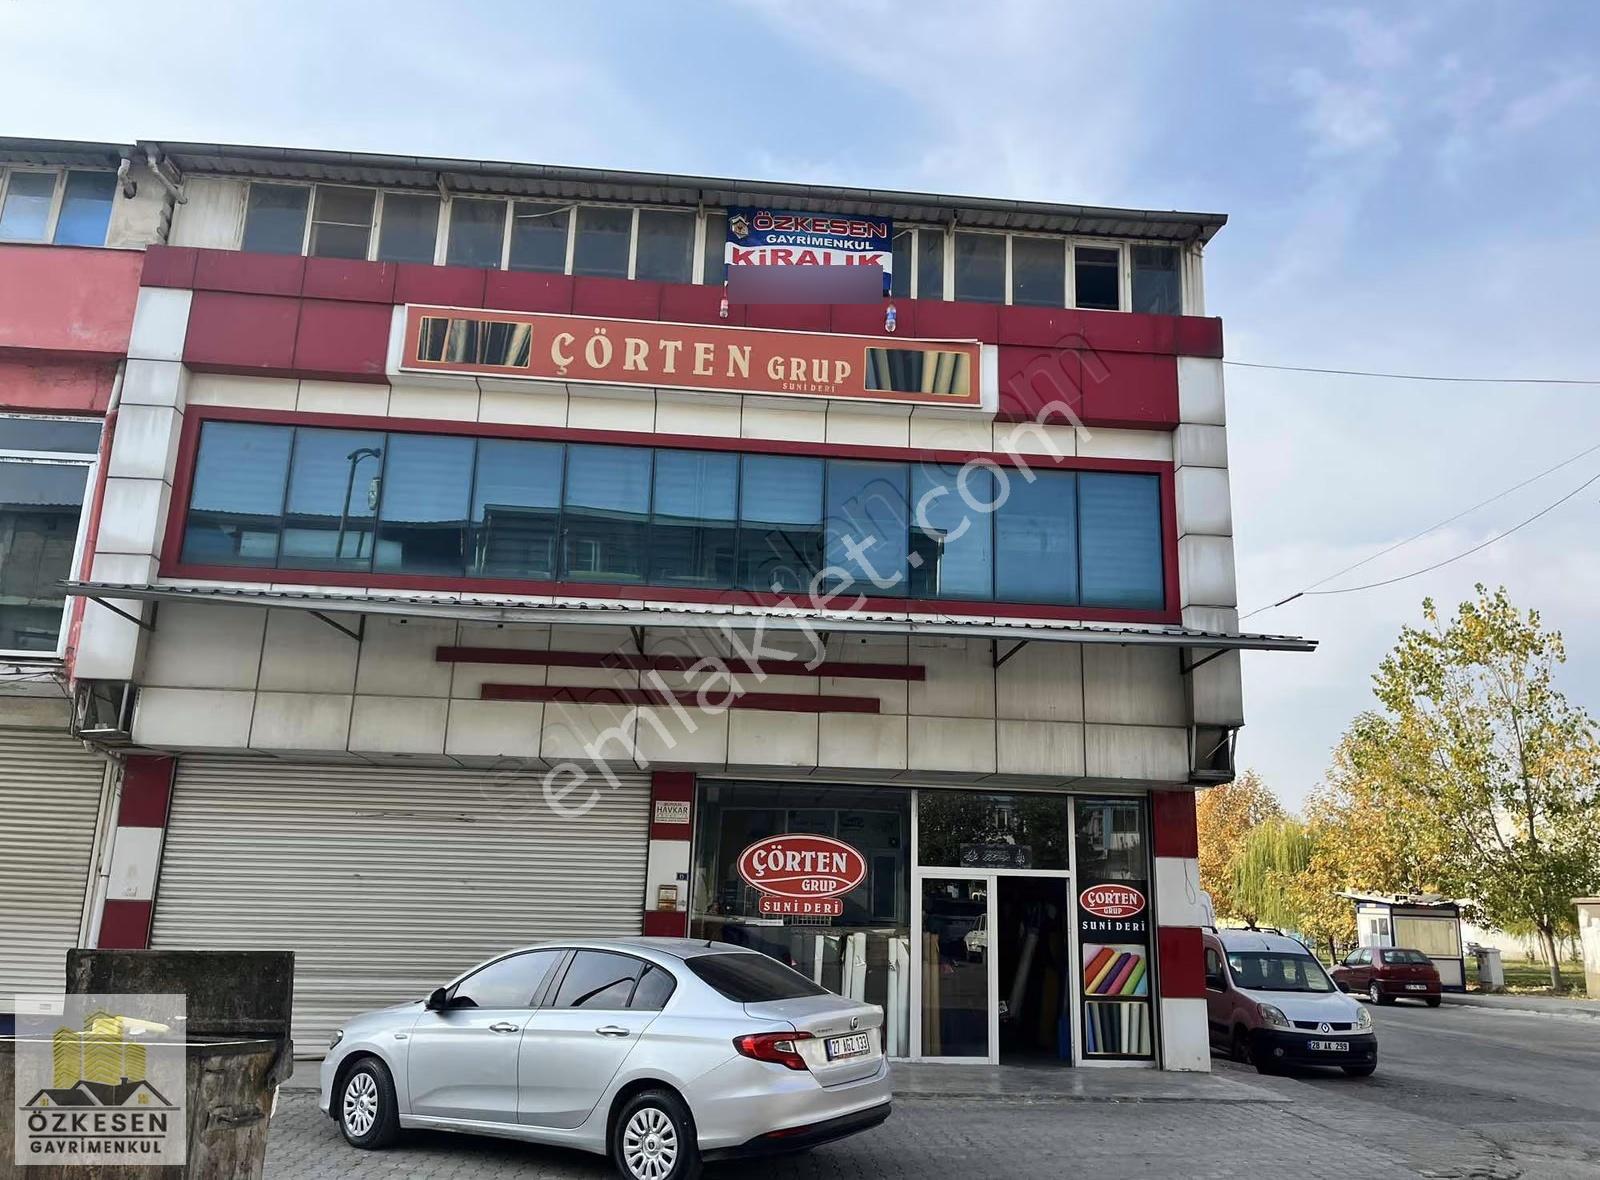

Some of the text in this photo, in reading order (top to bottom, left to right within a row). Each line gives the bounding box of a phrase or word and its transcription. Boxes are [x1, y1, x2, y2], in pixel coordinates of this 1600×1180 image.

[753, 210, 887, 239] ÖZKESEN
[766, 234, 874, 250] GAYRİMENKUL
[551, 327, 852, 384] ÇÖRTEN GRUP
[752, 845, 847, 876] ÇÖRTEN
[802, 879, 837, 892] GRUP
[763, 899, 839, 913] SUNİ DERİ
[1104, 907, 1122, 915] GRUP
[1082, 920, 1145, 931] SUNİ DERİ
